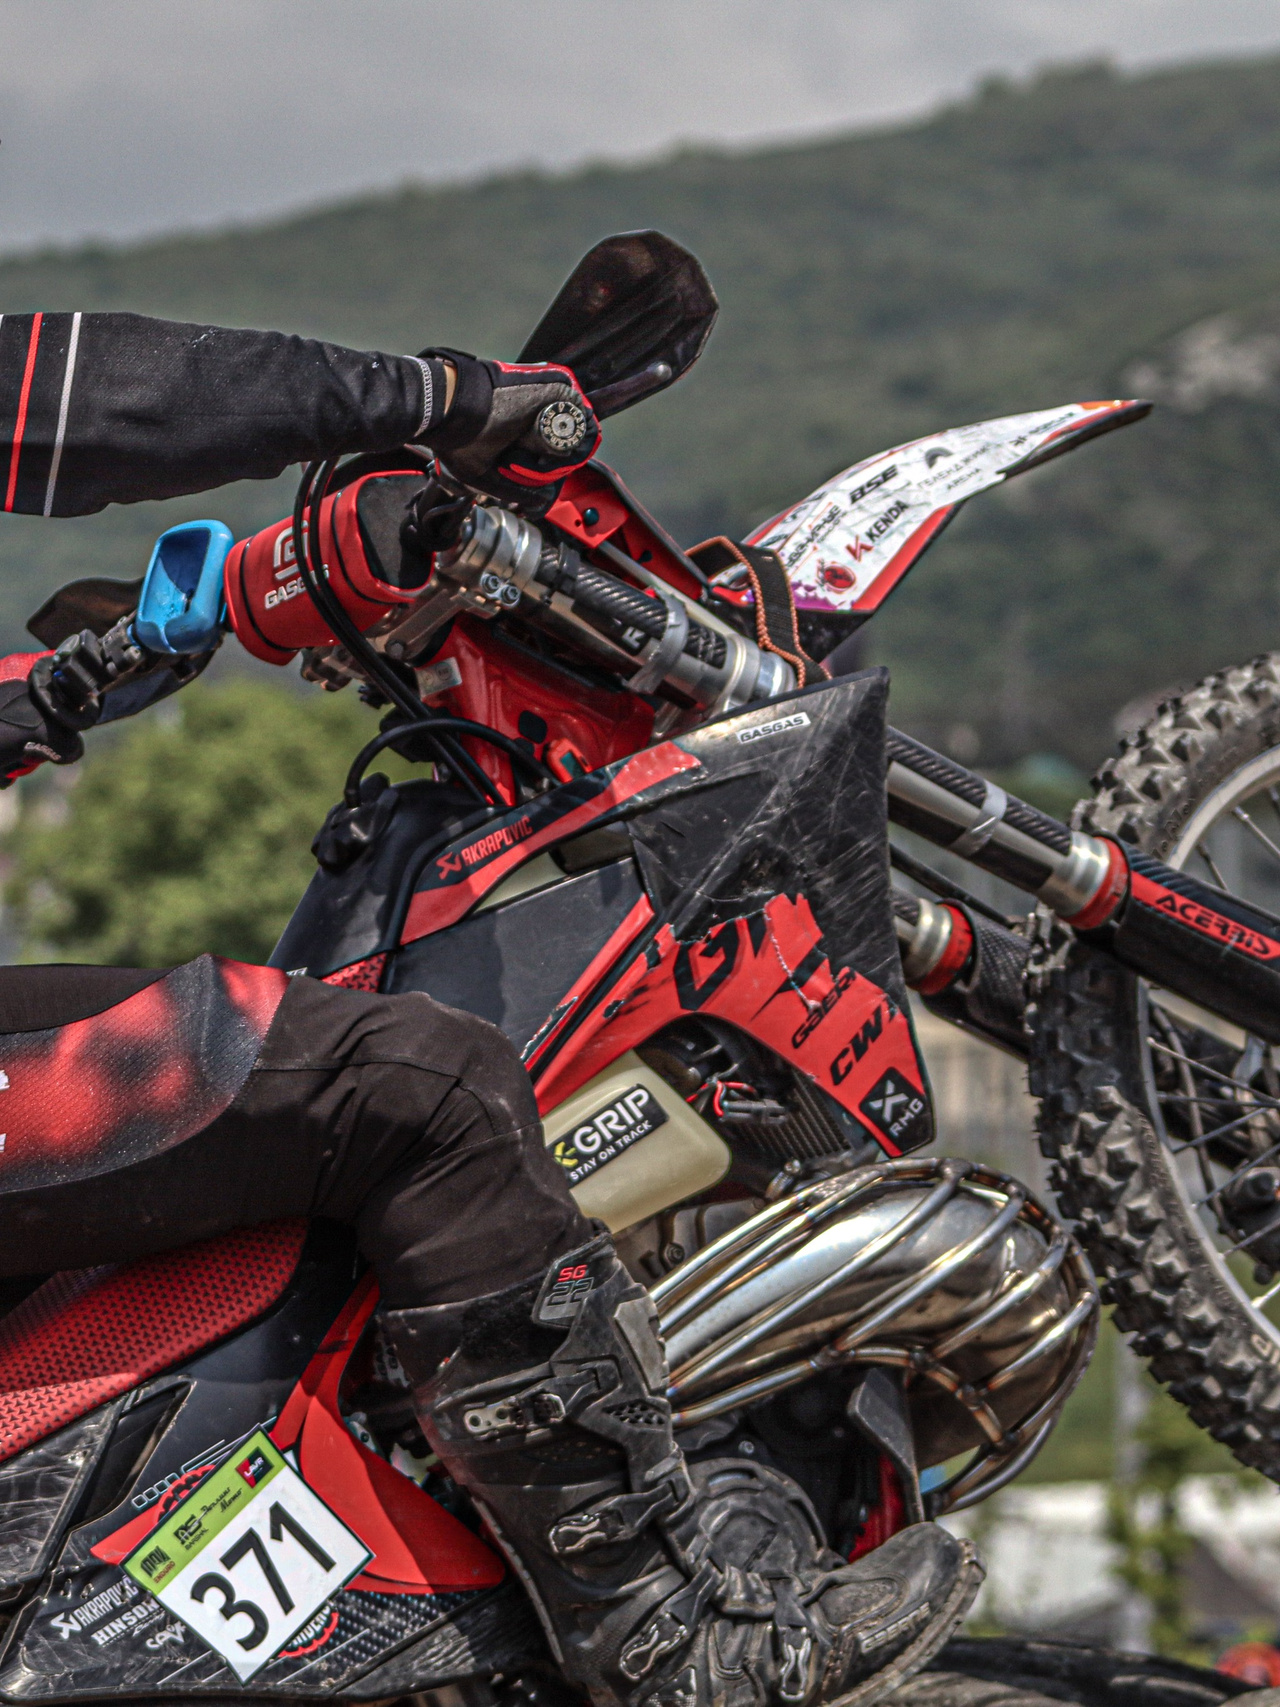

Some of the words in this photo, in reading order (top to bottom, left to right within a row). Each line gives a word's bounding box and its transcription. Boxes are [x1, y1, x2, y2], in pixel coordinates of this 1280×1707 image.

[865, 500, 910, 542] KENDA
[739, 715, 805, 744] GASGAS
[889, 1098, 924, 1138] RMG
[570, 1157, 597, 1180] STAY
[599, 1145, 616, 1160] ON
[615, 1120, 652, 1148] TRACK
[558, 1263, 588, 1283] SG
[190, 1500, 336, 1652] 371
[91, 1596, 160, 1645] HINSON
